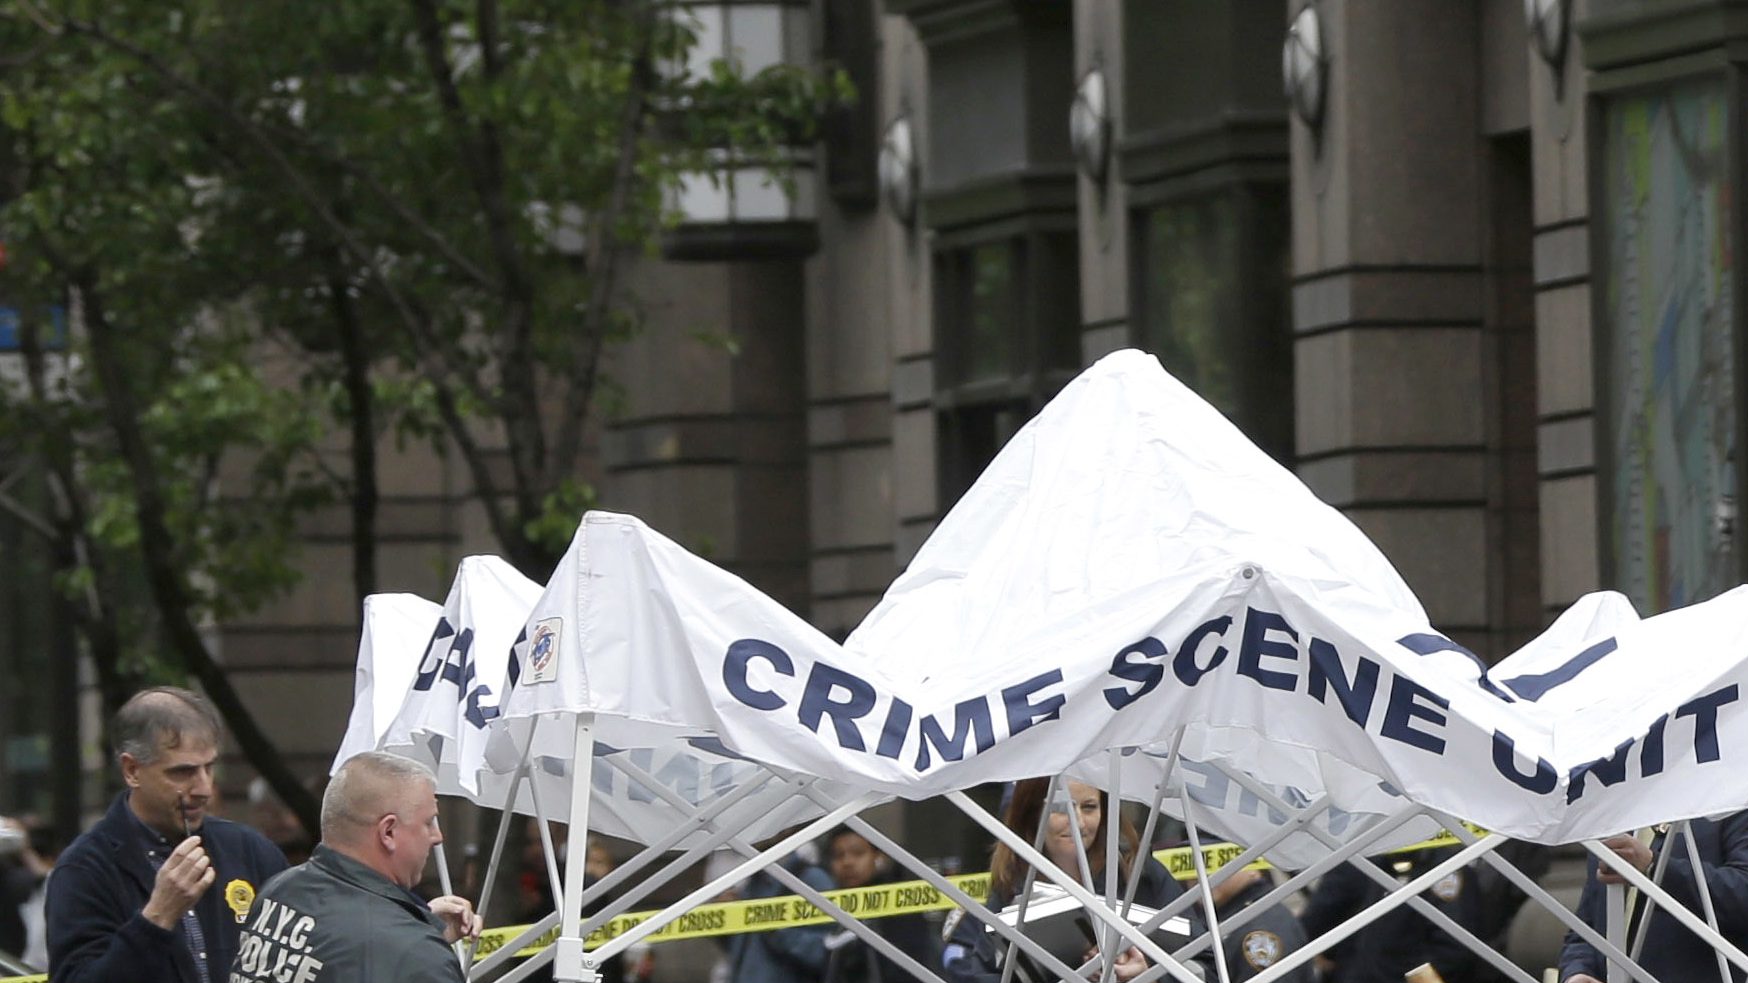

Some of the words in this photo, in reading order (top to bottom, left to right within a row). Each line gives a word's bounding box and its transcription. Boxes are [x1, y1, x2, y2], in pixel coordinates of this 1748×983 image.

[722, 637, 1067, 773] CRIME
[1102, 604, 1450, 756] SCENE
[1492, 683, 1740, 805] UNIT
[678, 910, 726, 932] CROSS
[744, 902, 787, 925] CRIME
[840, 894, 859, 913] DO
[862, 891, 890, 911] NOT
[895, 885, 941, 907] CROSS
